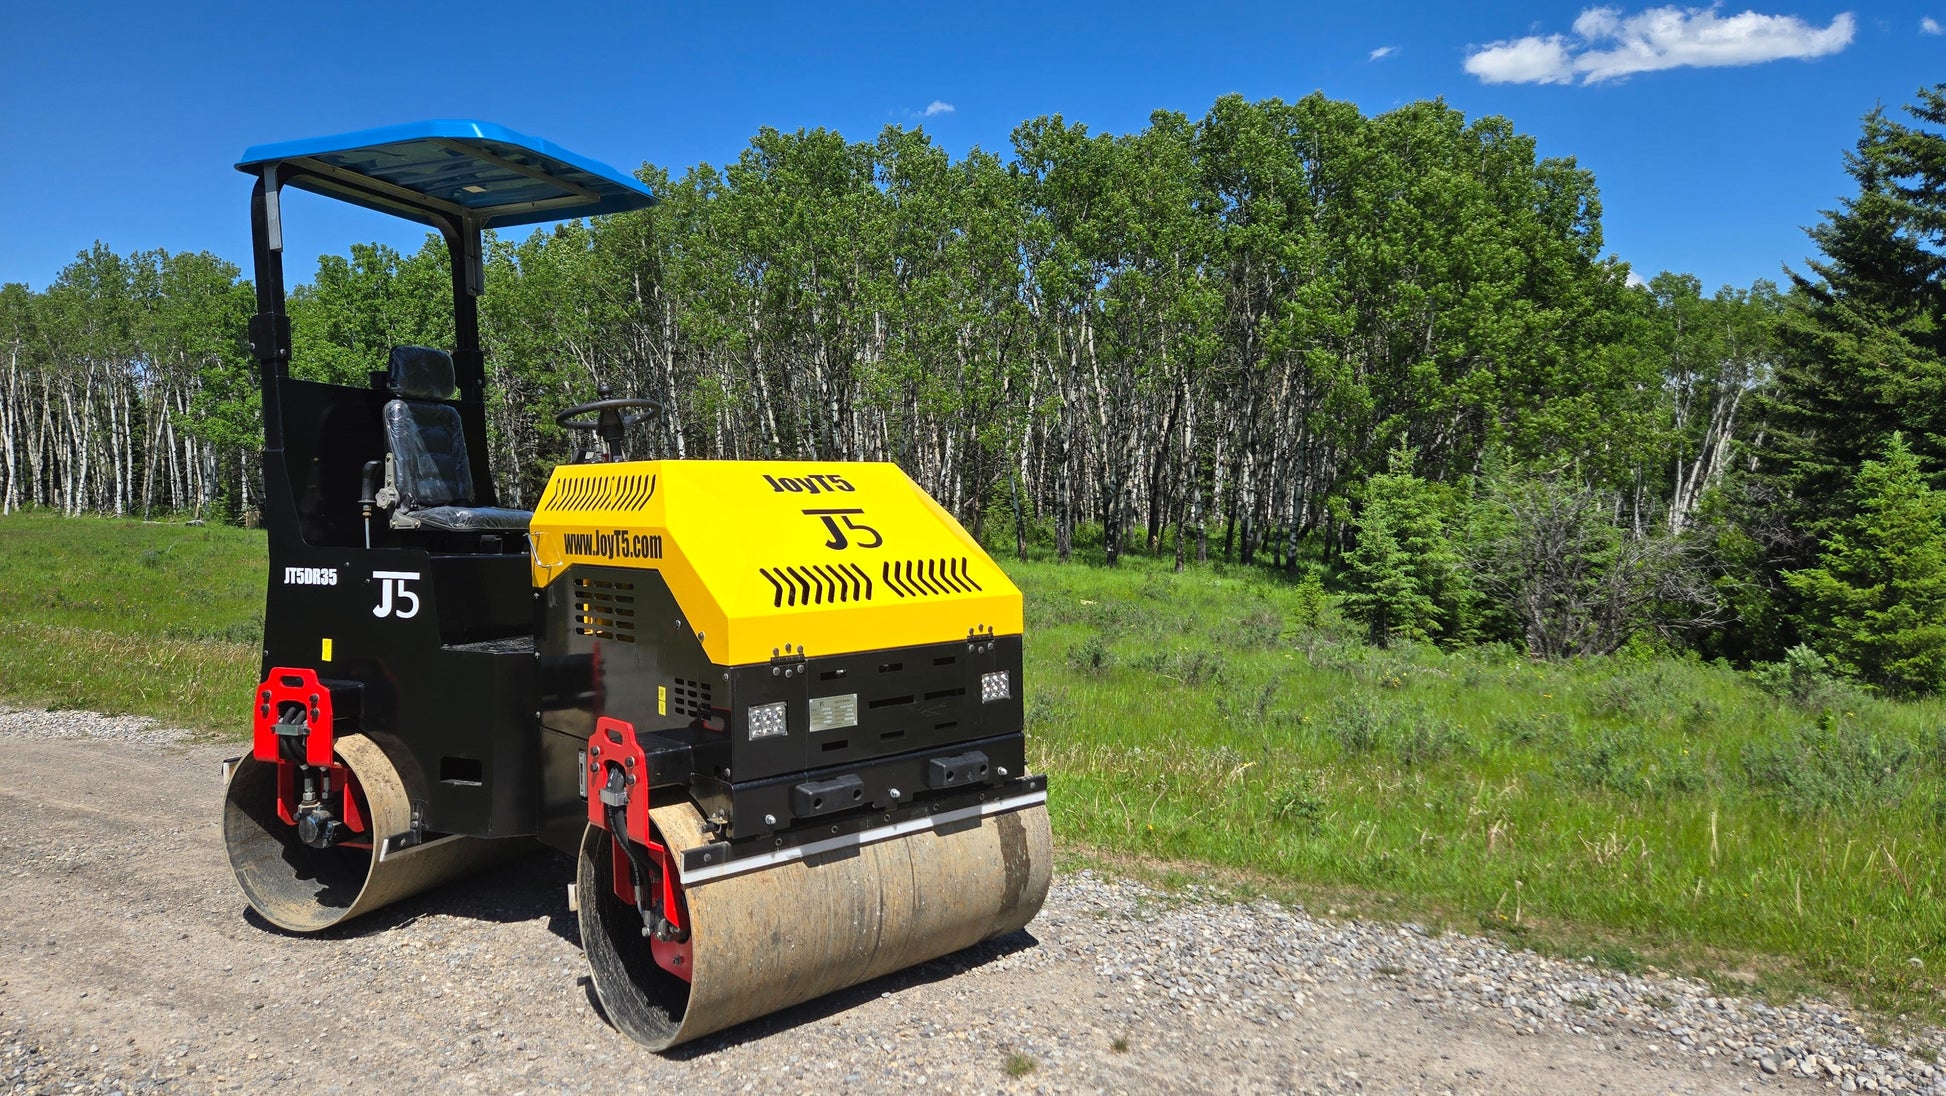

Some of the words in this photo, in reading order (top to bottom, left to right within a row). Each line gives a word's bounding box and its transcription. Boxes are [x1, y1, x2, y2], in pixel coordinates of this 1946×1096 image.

[762, 475, 856, 494] JoyT5
[564, 529, 663, 560] www.JoyT5.com
[283, 567, 338, 586] JT5DR35
